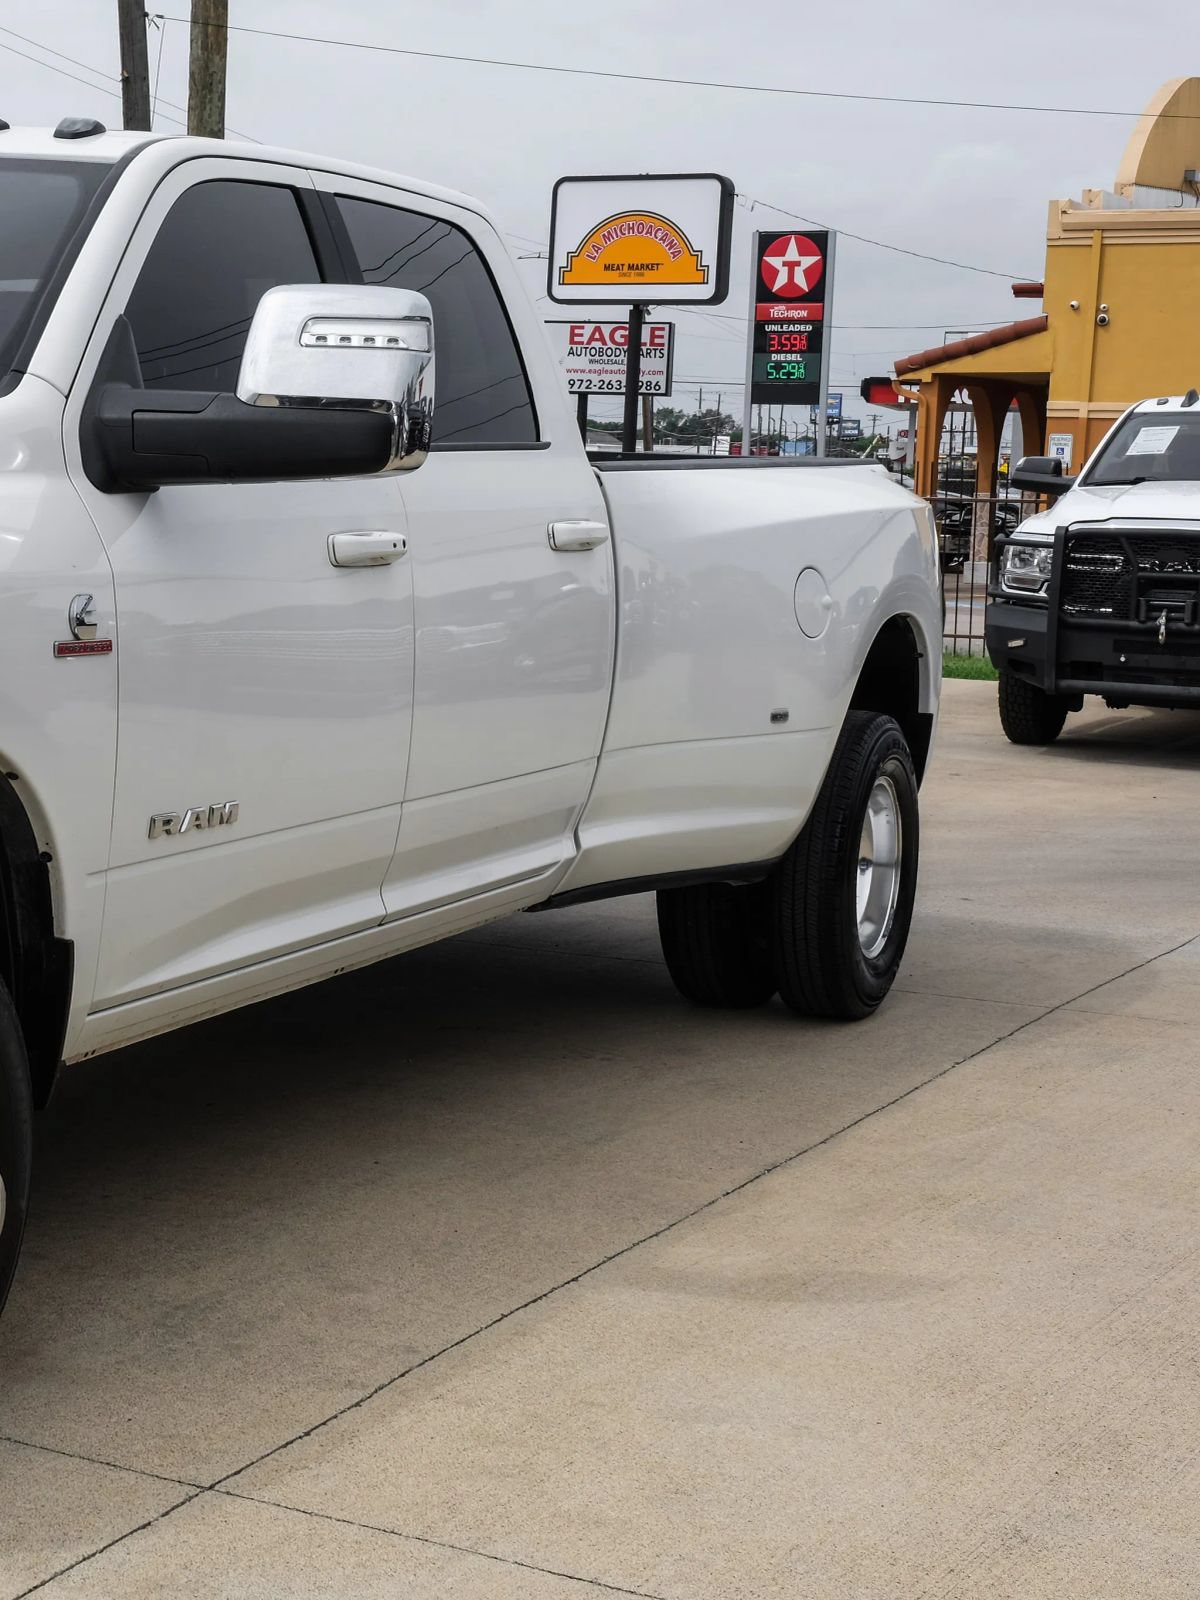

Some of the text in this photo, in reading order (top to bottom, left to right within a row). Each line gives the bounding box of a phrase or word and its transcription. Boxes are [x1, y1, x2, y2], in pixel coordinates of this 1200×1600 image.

[585, 220, 684, 262] LA MICHOACANA
[627, 263, 660, 271] MARKET
[769, 308, 808, 319] TECHRON
[569, 325, 665, 347] EAGE
[567, 346, 665, 359] AUTOBODY ARTS
[771, 353, 803, 361] DIESEL
[568, 378, 662, 391] 972-263-986
[147, 800, 240, 839] RAM
